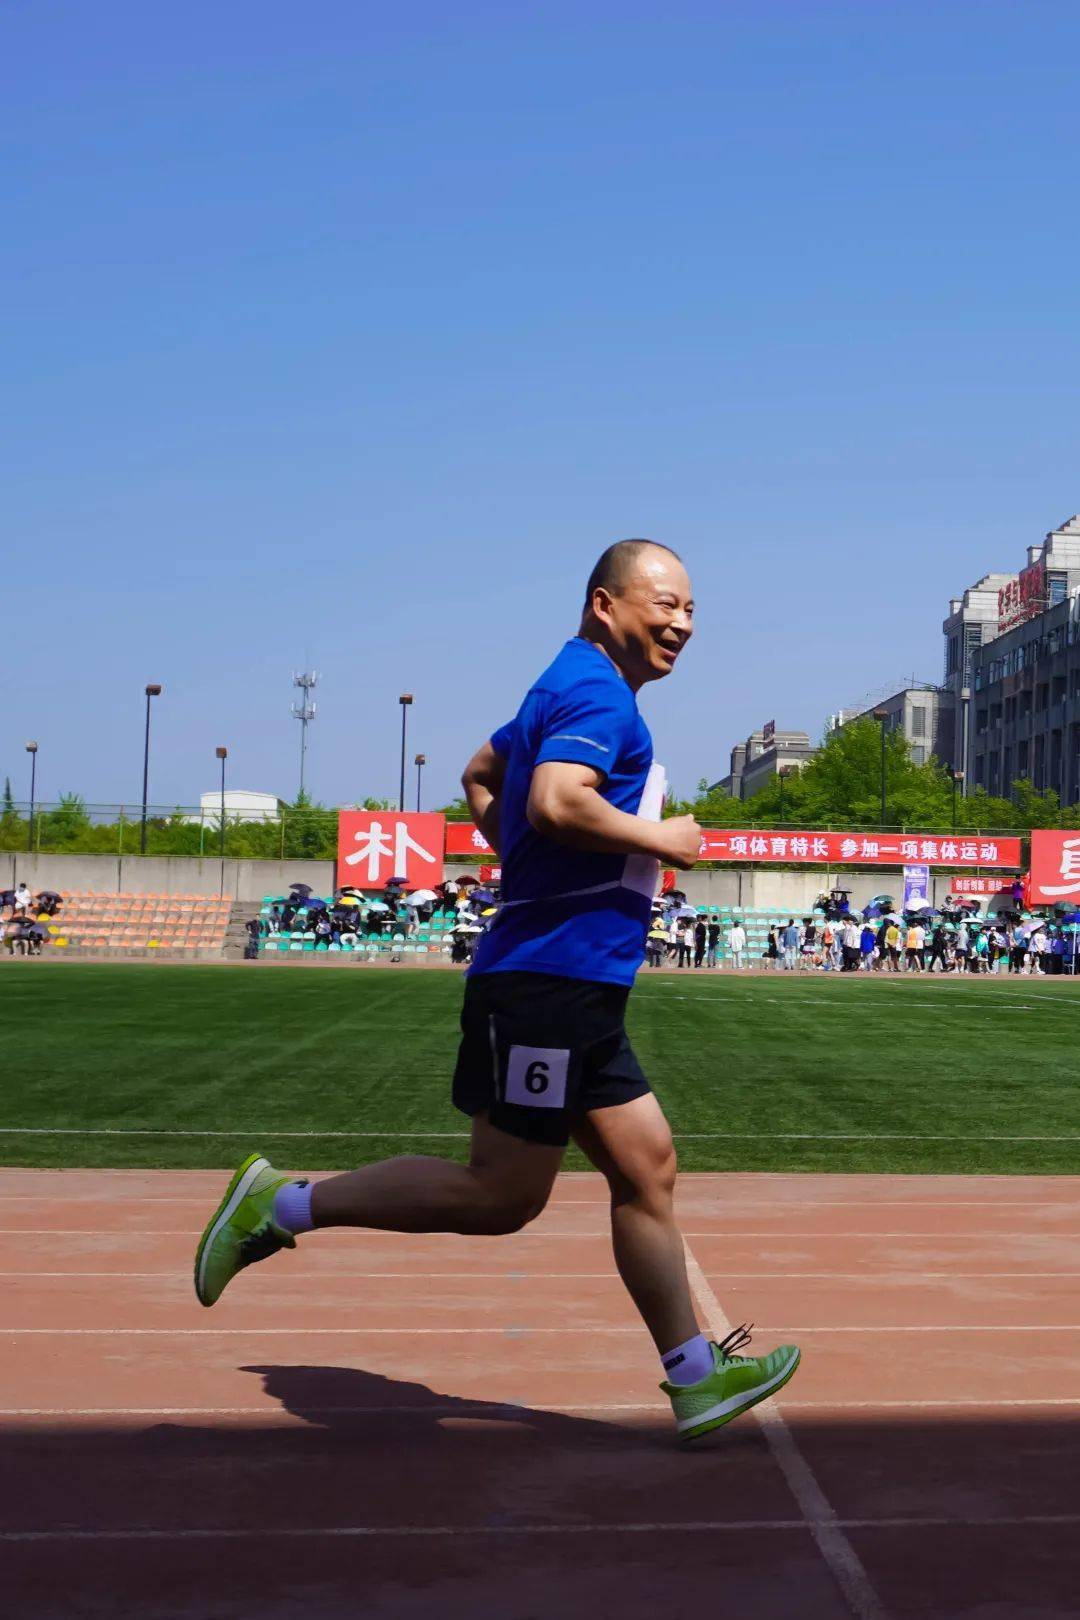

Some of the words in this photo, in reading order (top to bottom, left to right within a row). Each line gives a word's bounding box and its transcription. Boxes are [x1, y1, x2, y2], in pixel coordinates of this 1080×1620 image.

[345, 821, 437, 882] 朴
[840, 838, 998, 861] 参加一项集体运动
[525, 1061, 549, 1094] 6
